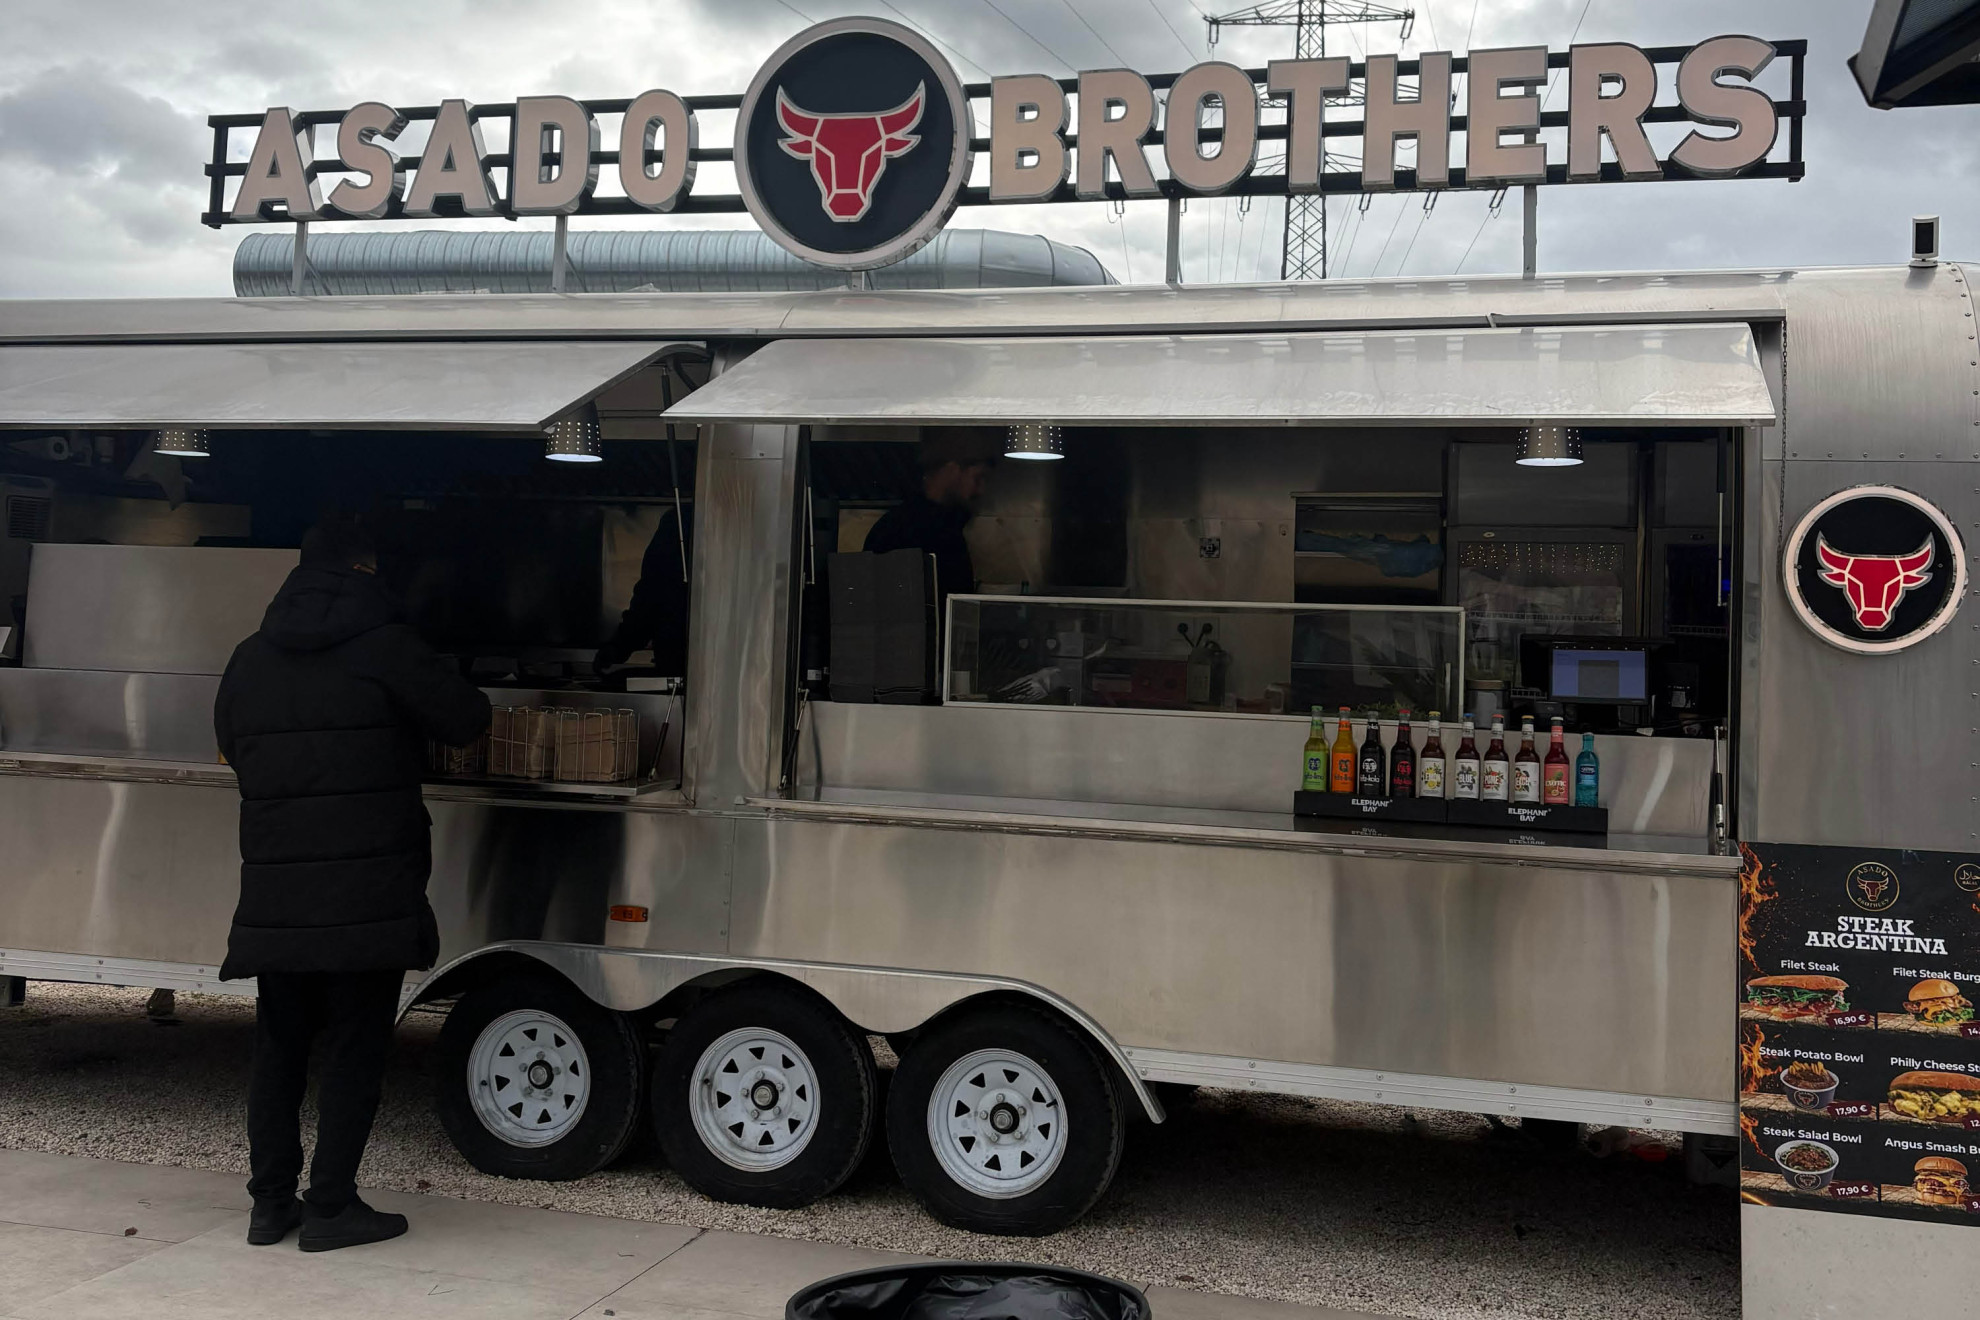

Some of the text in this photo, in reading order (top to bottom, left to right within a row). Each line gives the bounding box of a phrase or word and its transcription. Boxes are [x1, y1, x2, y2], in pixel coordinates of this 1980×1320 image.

[231, 35, 1779, 222] ASADO BROTHERS
[1458, 773, 1473, 784] BLUE
[1351, 798, 1390, 807] ELEPHANT
[1362, 805, 1378, 813] BAY
[1508, 807, 1548, 816] ELEPHANT
[1857, 866, 1889, 877] ASADO
[1856, 897, 1889, 908] BROTHERS
[1837, 915, 1915, 936] STEAK
[1804, 931, 1949, 955] ARGENTINA
[1780, 959, 1840, 973] Filet Steak
[1892, 967, 1917, 978] Filet
[1919, 969, 1952, 980] Steak
[1833, 1014, 1867, 1026] 16,90 €
[1758, 1046, 1864, 1063] Steak Potato Bowl
[1890, 1057, 1921, 1070] Philly
[1923, 1060, 1966, 1072] Cheese
[1834, 1104, 1868, 1116] 17,90 €
[1763, 1127, 1862, 1144] Steak Salad Bowl
[1884, 1137, 1923, 1150] Angus
[1925, 1141, 1966, 1153] Smash
[1836, 1184, 1869, 1196] 17,90 €
